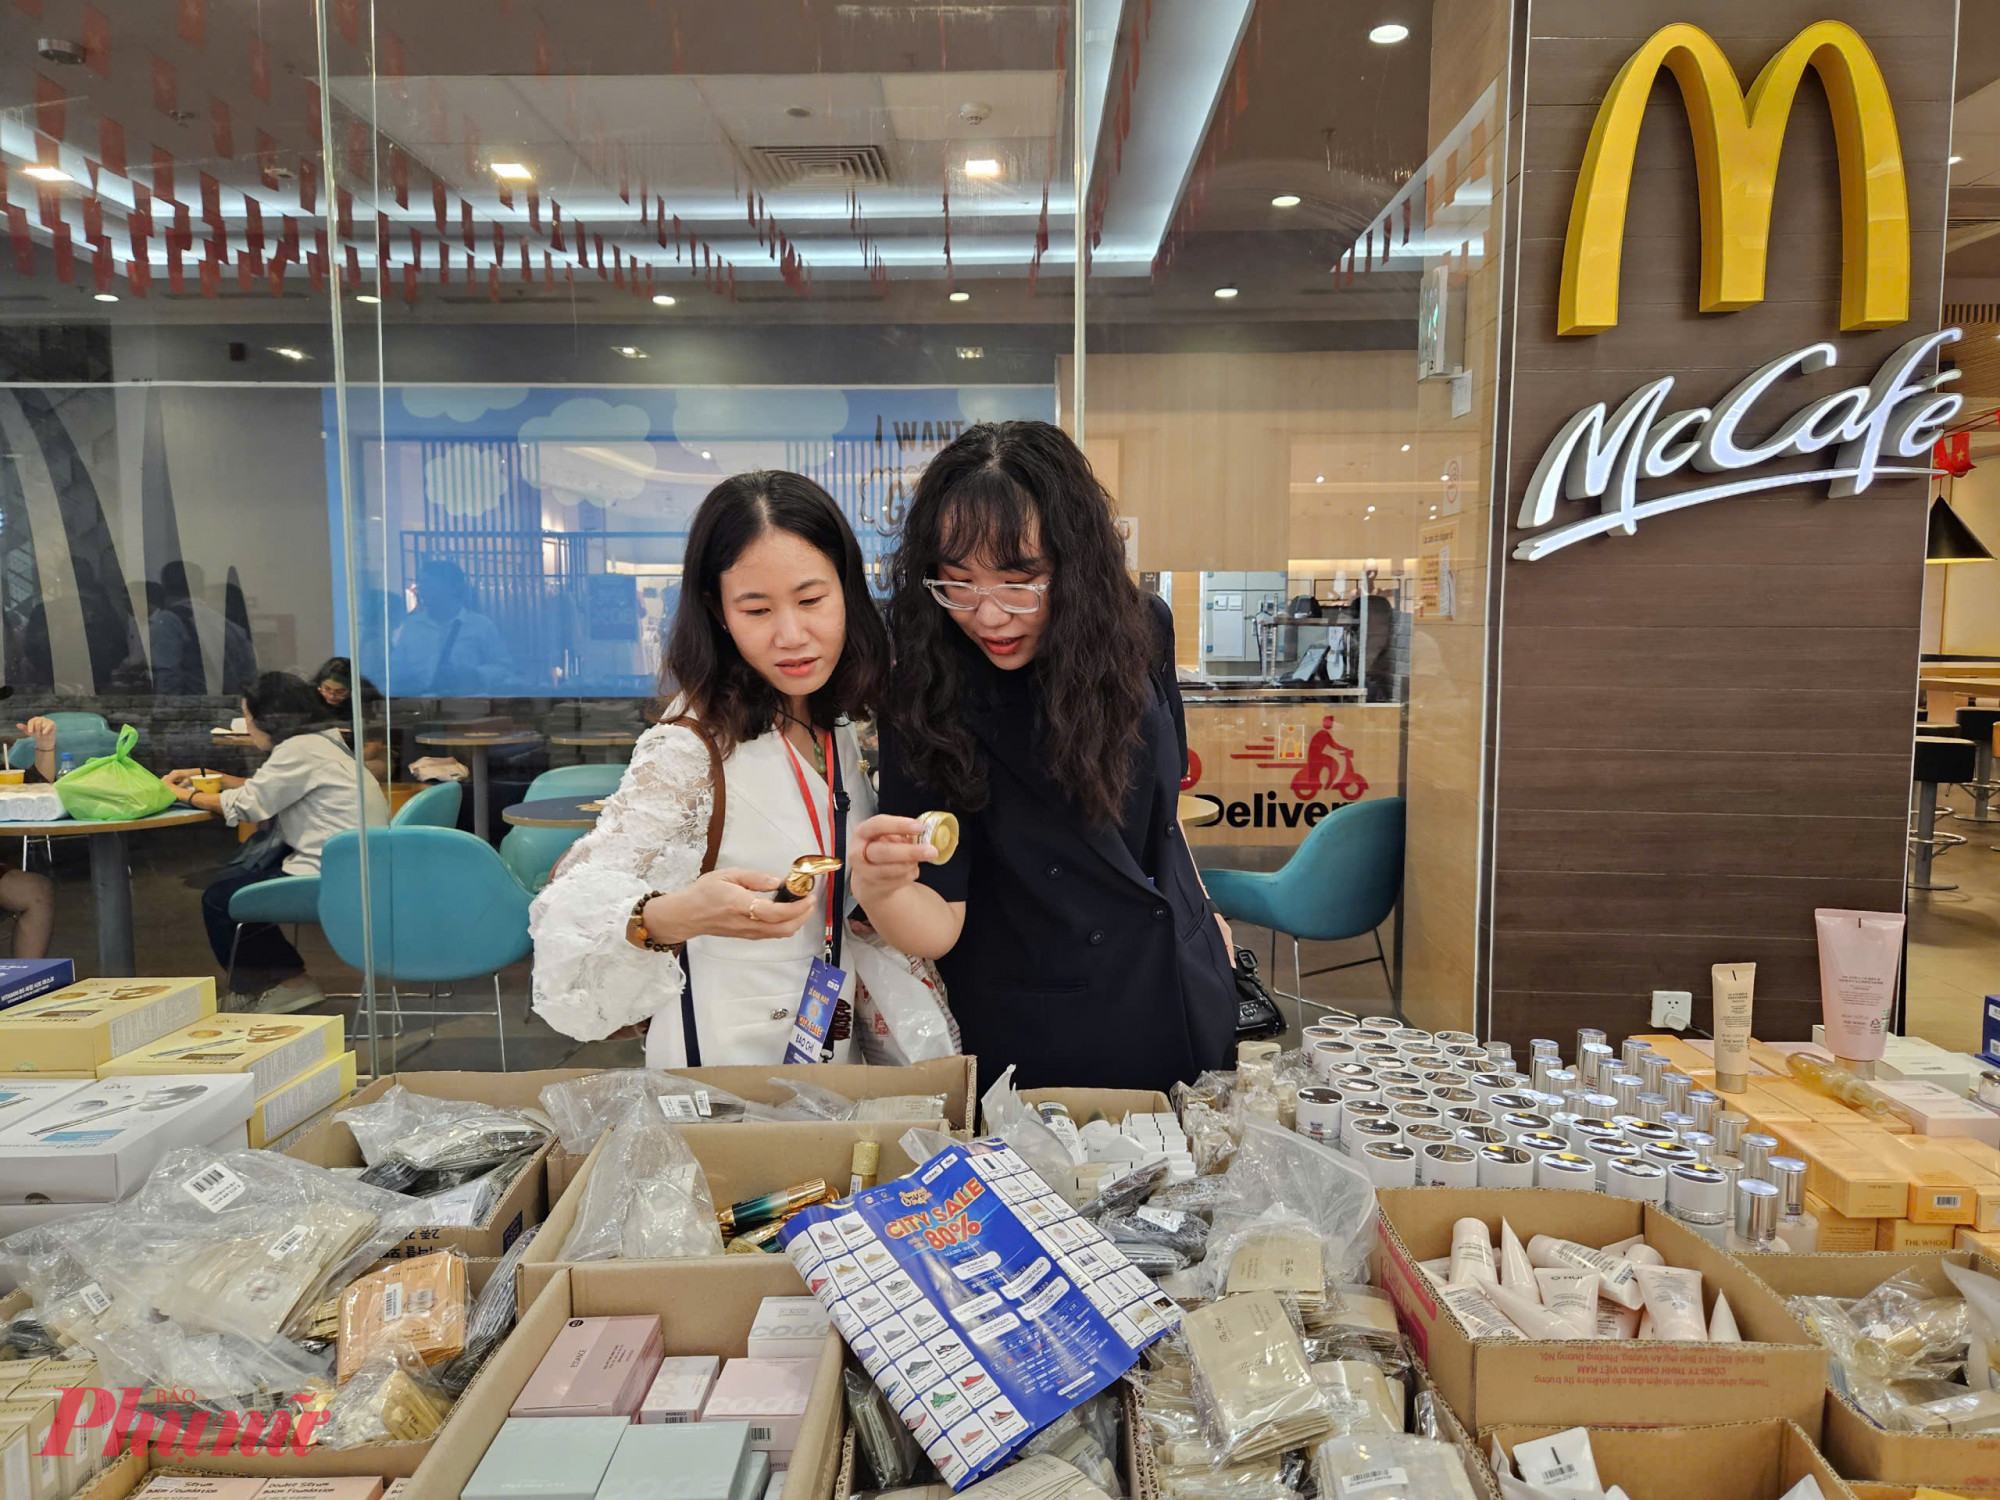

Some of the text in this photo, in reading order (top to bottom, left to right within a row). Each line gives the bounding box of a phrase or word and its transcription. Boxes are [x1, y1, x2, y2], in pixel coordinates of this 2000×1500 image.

[893, 420, 965, 452] WANT
[1514, 327, 1963, 545] McCafé
[1195, 790, 1355, 828] Delive
[885, 1177, 986, 1239] CITY SALE
[923, 1211, 982, 1250] 80%
